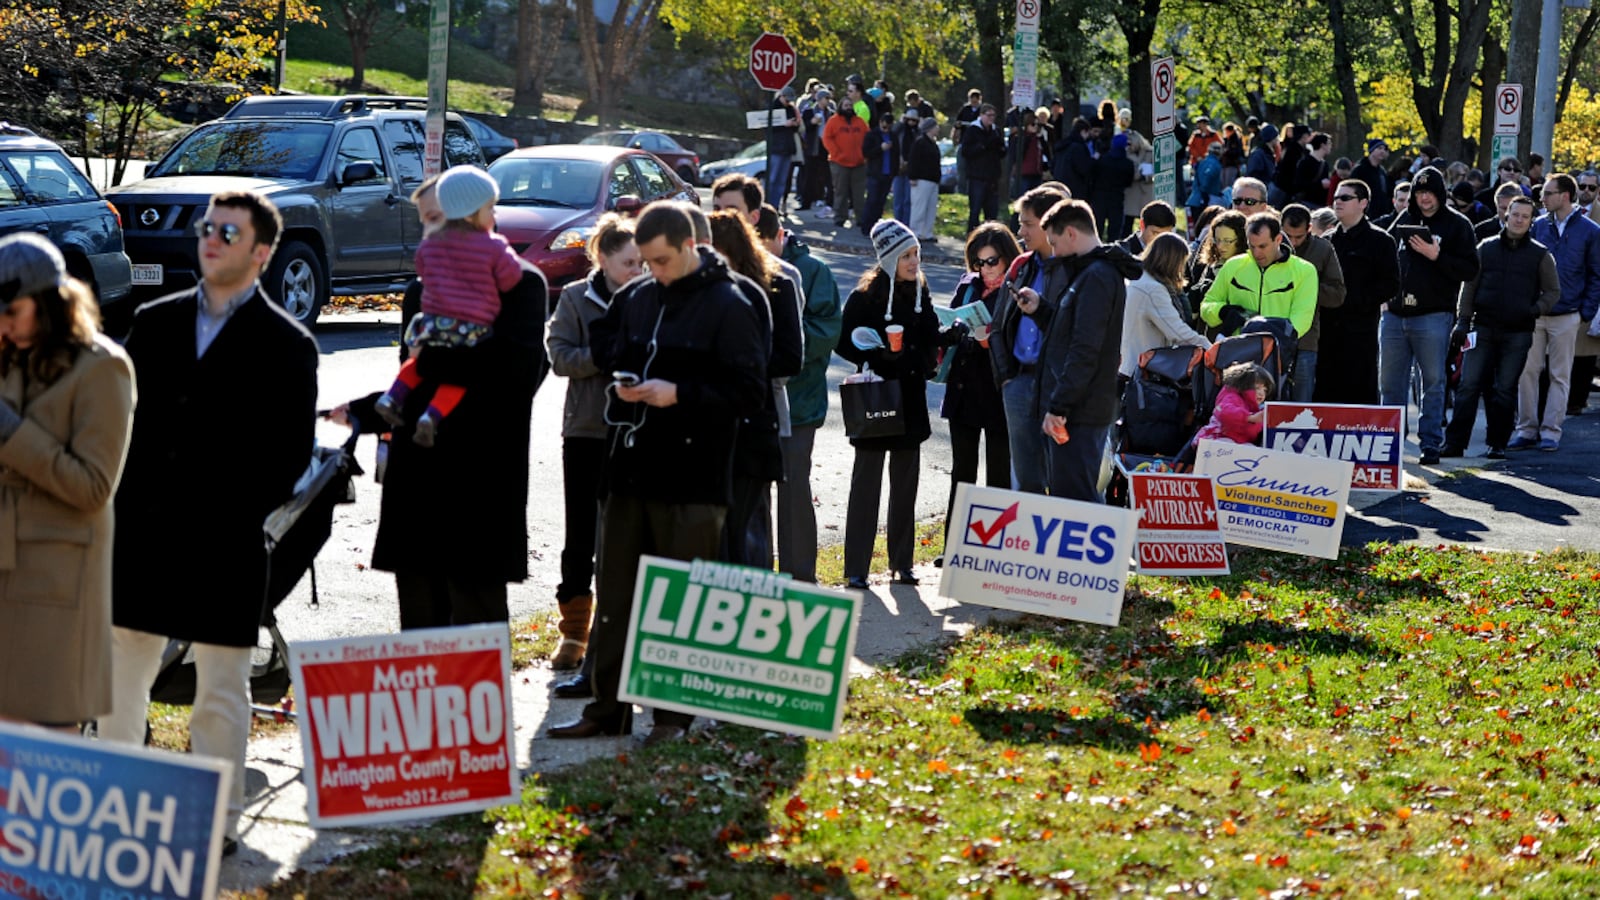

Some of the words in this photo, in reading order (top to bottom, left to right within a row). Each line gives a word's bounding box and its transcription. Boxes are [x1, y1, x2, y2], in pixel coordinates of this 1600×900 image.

[753, 49, 793, 75] STOP
[1273, 432, 1394, 462] KAINE
[1146, 479, 1200, 498] PATRICK
[1217, 455, 1338, 497] Emma
[1146, 498, 1204, 525] MURRAY
[1219, 500, 1238, 511] FOR
[1248, 506, 1287, 519] SCHOOL
[1296, 513, 1331, 526] BOARD
[1224, 488, 1328, 513] Violand-Sanchez
[1227, 515, 1299, 534] DEMOCRAT
[1032, 515, 1116, 565] YES
[1141, 543, 1224, 563] CONGRESS
[689, 560, 788, 599] DEMOCRAT
[949, 553, 1052, 582] ARLINGTON
[1056, 570, 1120, 594] BONDS
[982, 581, 1078, 605] arlingtonbonds.org
[640, 576, 849, 665] LIBBY!
[342, 645, 375, 660] Elect
[380, 642, 388, 658] A
[393, 641, 419, 657] New
[373, 663, 437, 691] Matt
[646, 644, 679, 662] FOR
[687, 652, 759, 677] COUNTY
[766, 664, 827, 690] BOARD
[640, 670, 825, 714] www.libbygarvey.com
[309, 680, 504, 760] WAVRO
[14, 750, 103, 778] DEMOCRAT
[321, 760, 396, 791] Arlington
[399, 754, 456, 783] County
[460, 746, 507, 774] Board
[6, 768, 178, 844] NOAH
[362, 786, 470, 809] Wavro2012.com
[0, 819, 196, 899] SIMON
